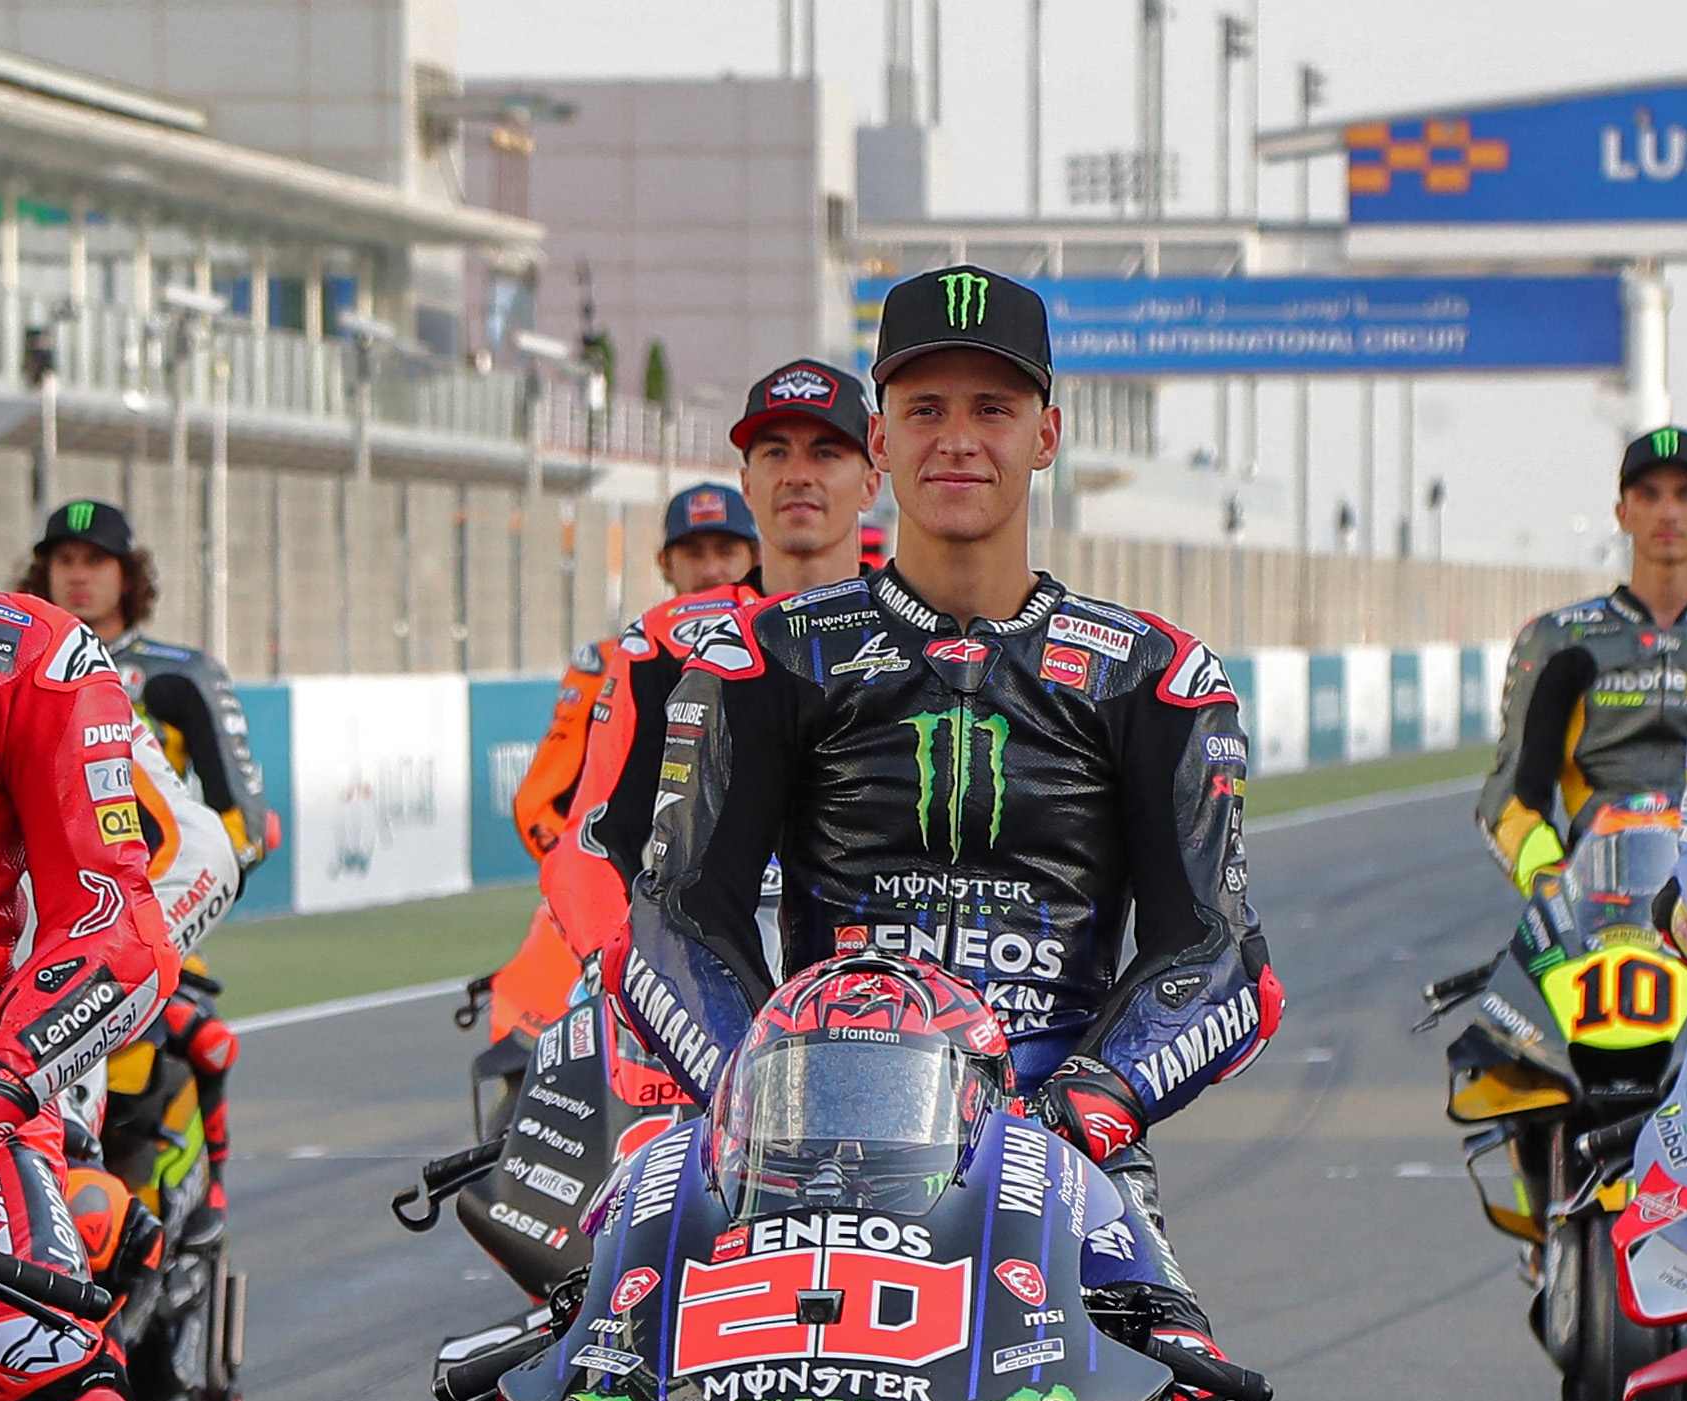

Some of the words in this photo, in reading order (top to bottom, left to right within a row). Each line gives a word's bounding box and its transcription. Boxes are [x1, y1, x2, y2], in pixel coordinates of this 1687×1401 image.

[878, 577, 939, 633] YAMAHA
[988, 590, 1055, 634] YAMAHA
[1070, 617, 1131, 651] YAMAHA
[1045, 656, 1086, 674] ENEOS
[874, 871, 1036, 905] MONSTER
[896, 899, 1012, 917] ENERGY
[1570, 953, 1678, 1040] 10
[28, 982, 115, 1056] Lenovo
[621, 946, 723, 1094] YAMAHA
[841, 1027, 901, 1045] fantom
[1482, 992, 1546, 1047] mooney
[45, 1002, 138, 1096] UnipolSai
[1135, 986, 1260, 1101] YAMAHA
[527, 1083, 596, 1121] kaspersky
[539, 1126, 586, 1160] Marsh
[503, 1156, 531, 1181] sky
[631, 1127, 695, 1228] YAMAHA
[997, 1125, 1049, 1218] YAMAHA
[489, 1203, 549, 1241] CASE
[750, 1215, 933, 1258] ENEOS
[586, 1317, 626, 1336] msi
[672, 1246, 974, 1377] 20
[1023, 1308, 1066, 1327] msi
